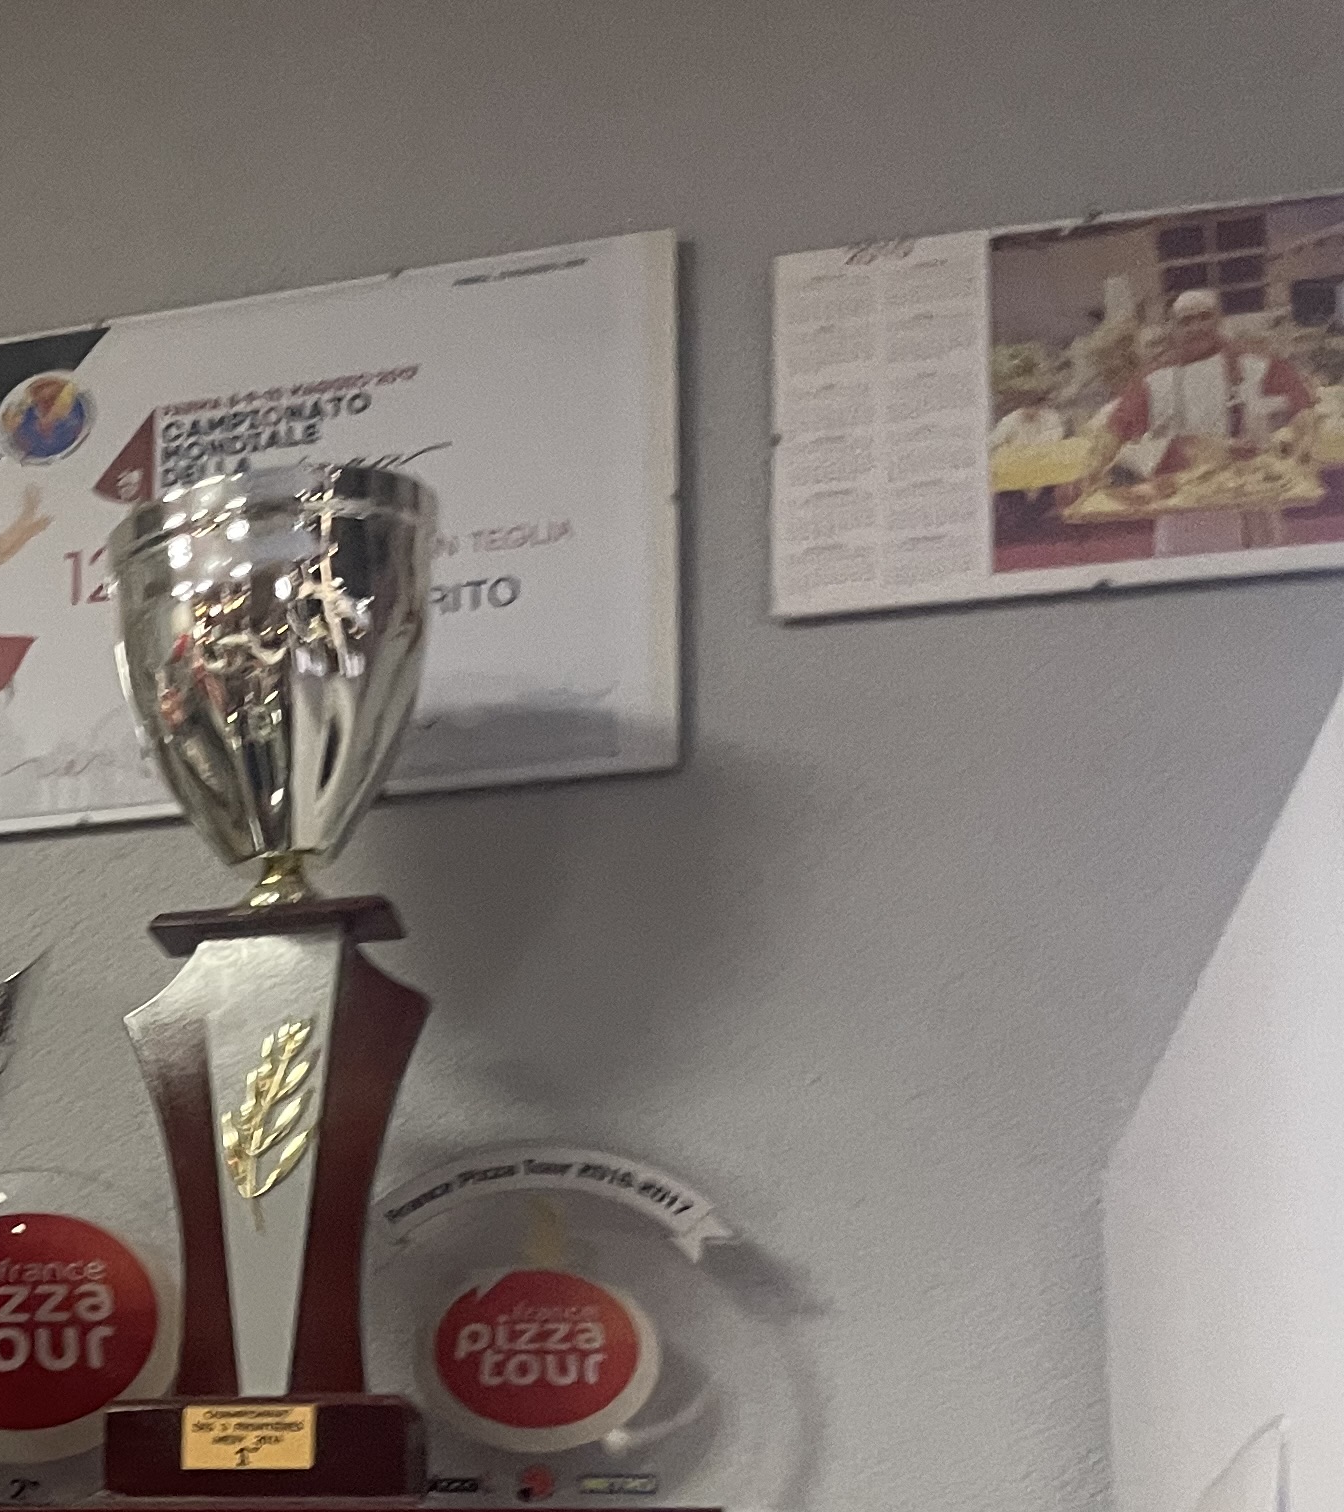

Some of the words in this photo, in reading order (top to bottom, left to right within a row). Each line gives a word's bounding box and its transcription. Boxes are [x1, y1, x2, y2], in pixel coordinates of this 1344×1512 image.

[162, 390, 374, 443] CAMPIONATO
[161, 417, 323, 464] MONDIALE
[453, 1313, 607, 1361] pizza
[478, 1348, 609, 1388] tour
